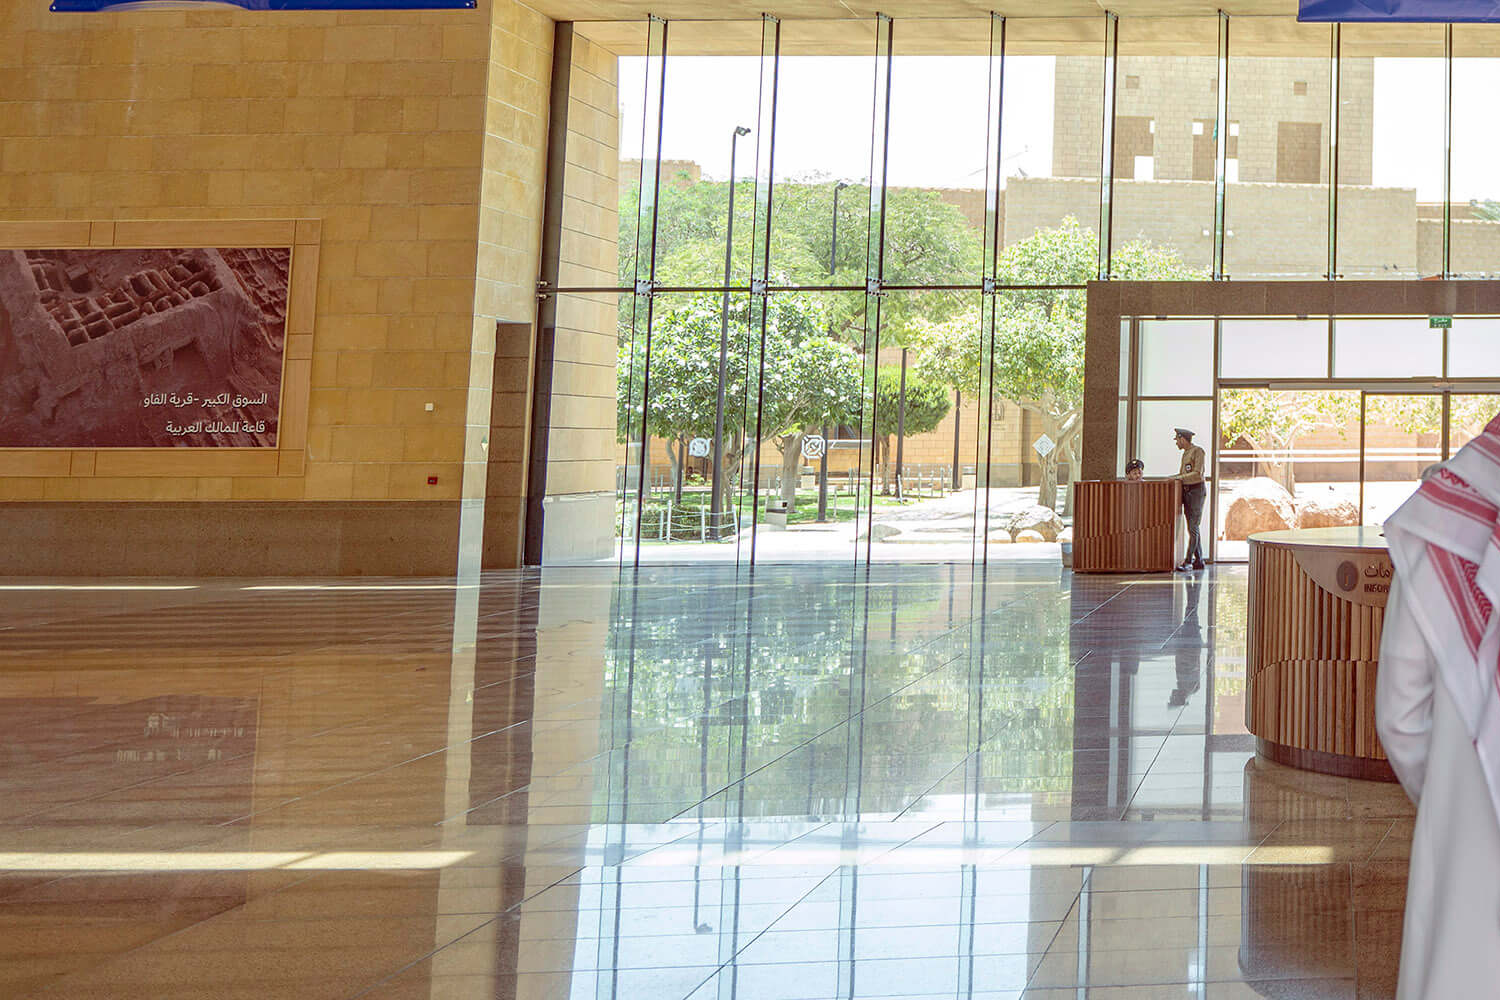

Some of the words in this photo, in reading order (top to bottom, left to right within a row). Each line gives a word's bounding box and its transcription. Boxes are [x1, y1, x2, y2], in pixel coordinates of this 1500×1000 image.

[201, 393, 230, 407] الكبير
[232, 392, 267, 408] السوق
[165, 420, 202, 435] العربية
[241, 420, 266, 433] قاعة
